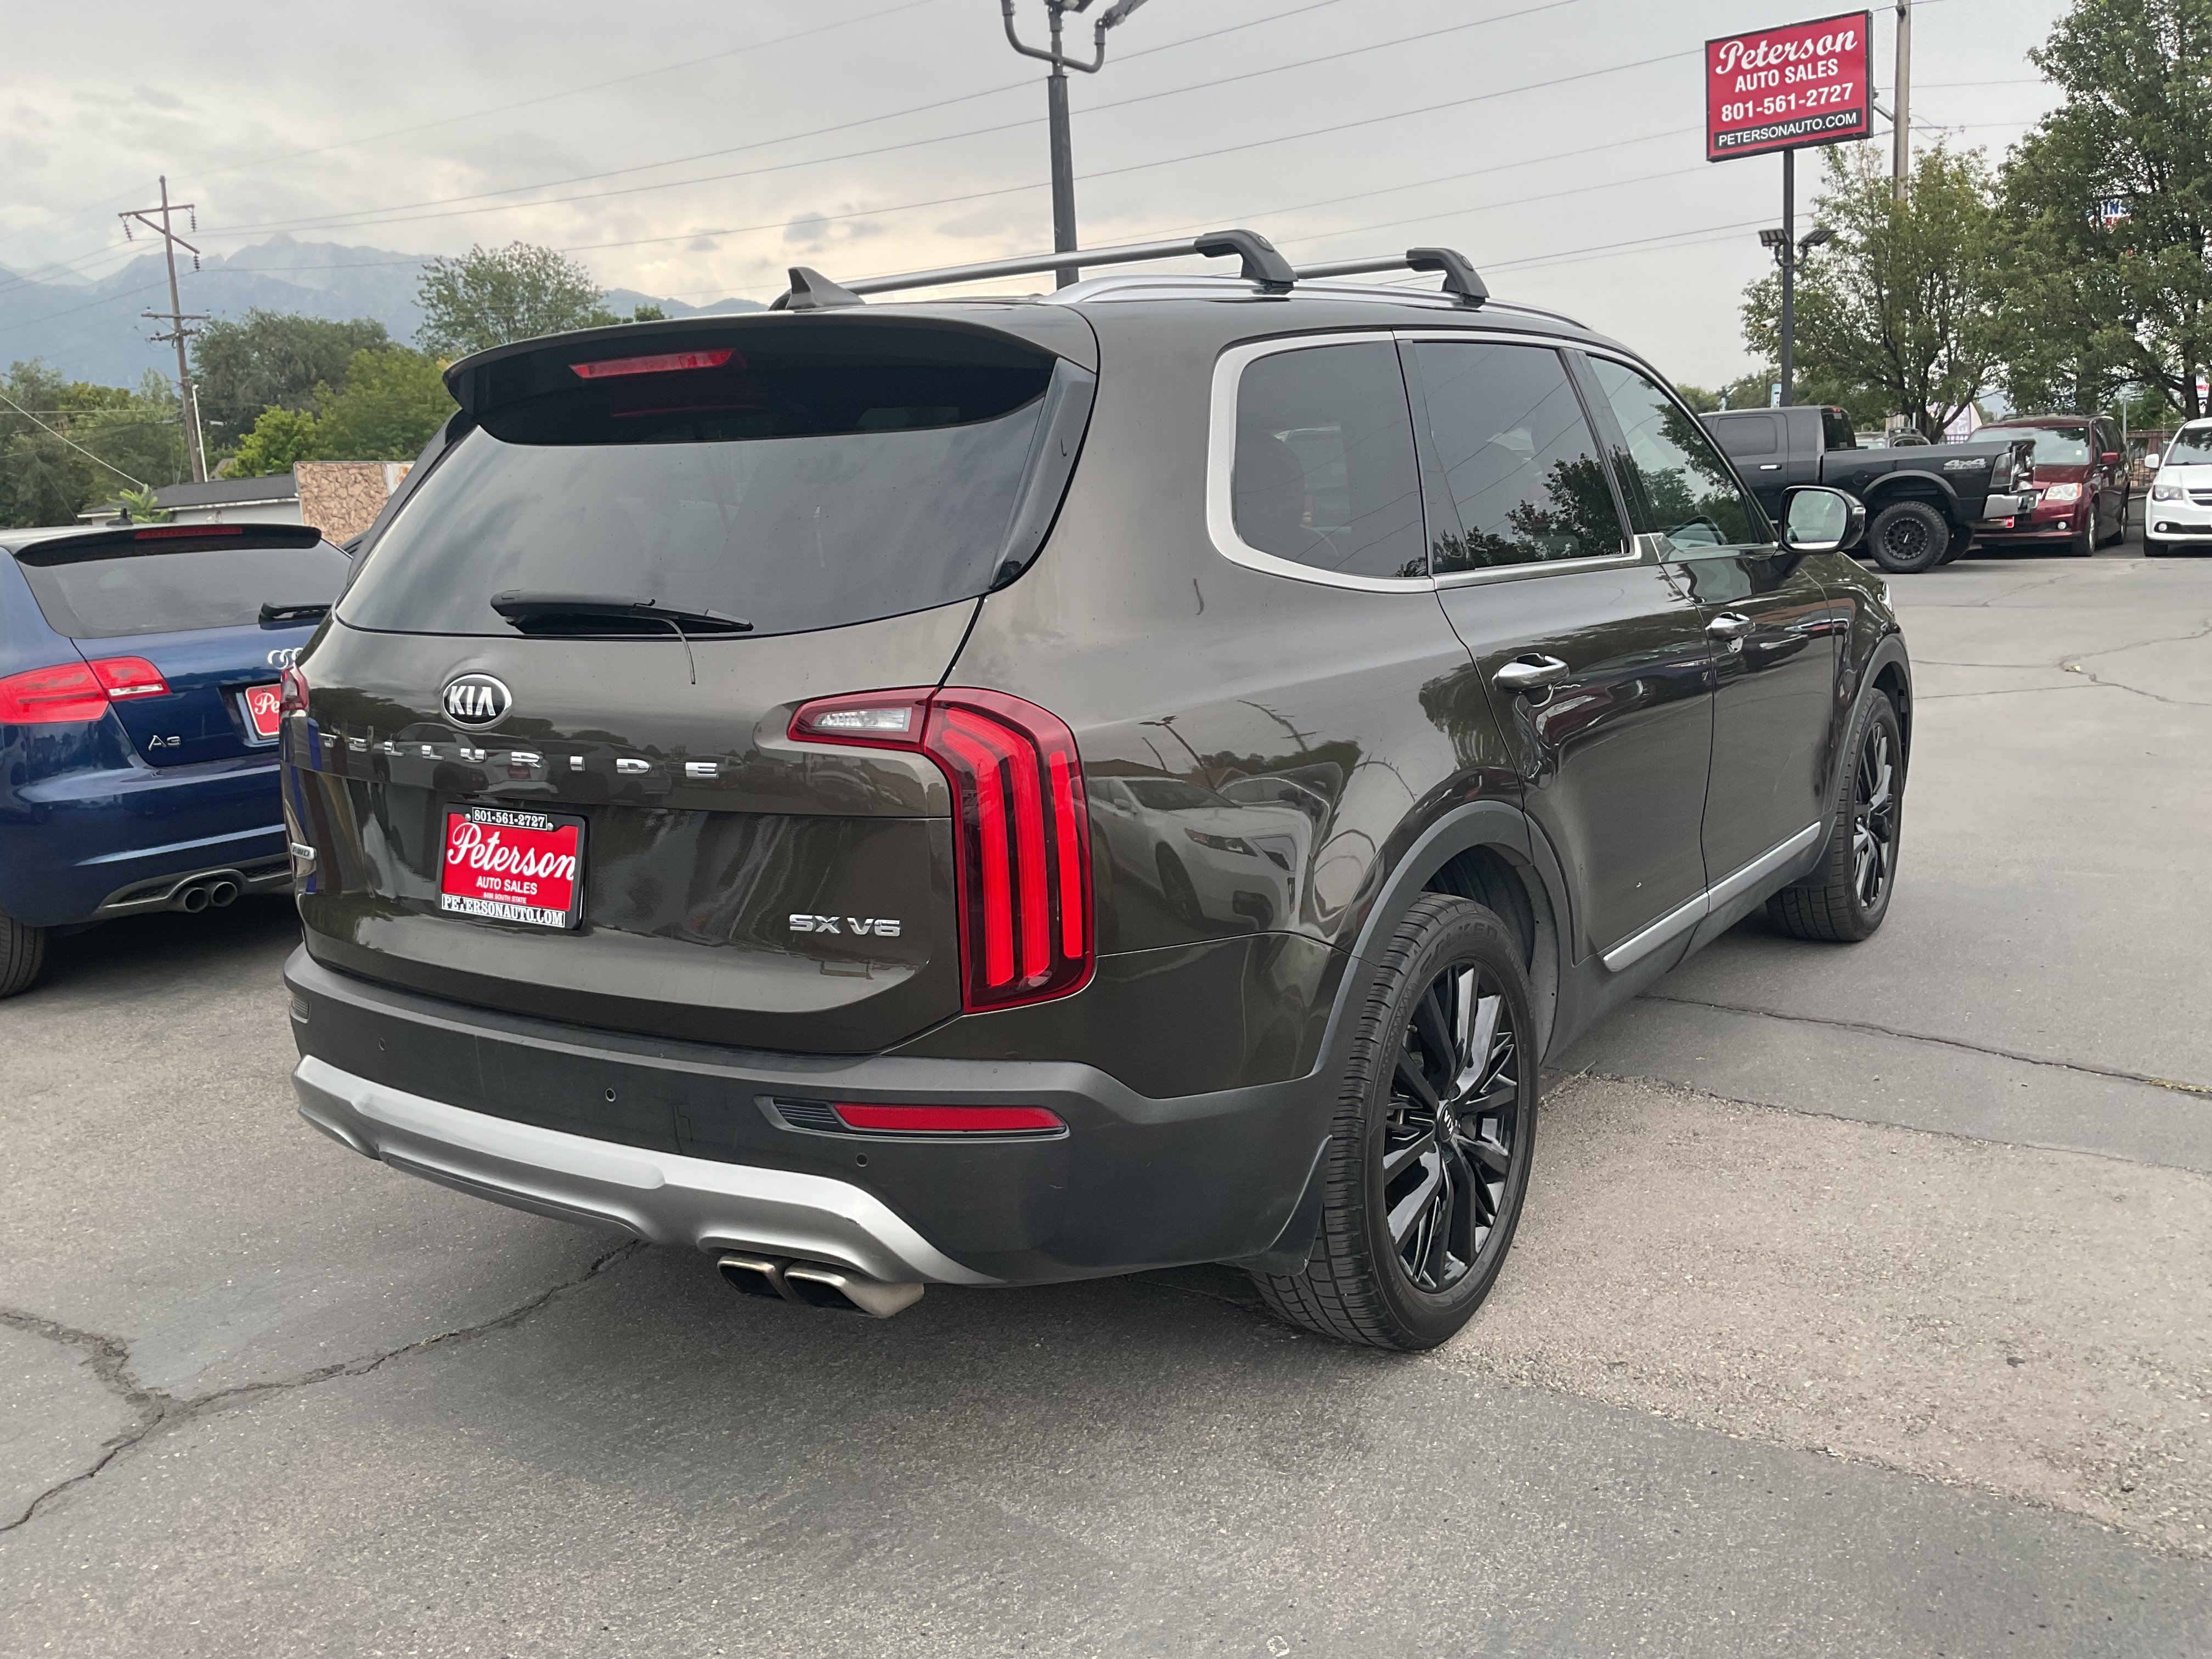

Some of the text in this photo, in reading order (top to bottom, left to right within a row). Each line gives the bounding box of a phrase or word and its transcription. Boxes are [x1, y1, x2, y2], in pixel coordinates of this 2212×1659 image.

[1716, 30, 1858, 75] Peterson
[1735, 58, 1838, 93] AUTO SALES
[1722, 82, 1853, 122] 801-561-2727
[1719, 112, 1857, 146] PETERSONAUTO.COM
[255, 692, 280, 715] Pe
[450, 685, 496, 716] KIA
[148, 735, 182, 751] A3
[474, 809, 545, 828] 801-561-2727
[448, 822, 576, 881] Peterson
[476, 876, 538, 895] AUTO SALES
[494, 893, 511, 901] SOUTH
[511, 895, 527, 904] STATE
[789, 914, 901, 937] SX V6
